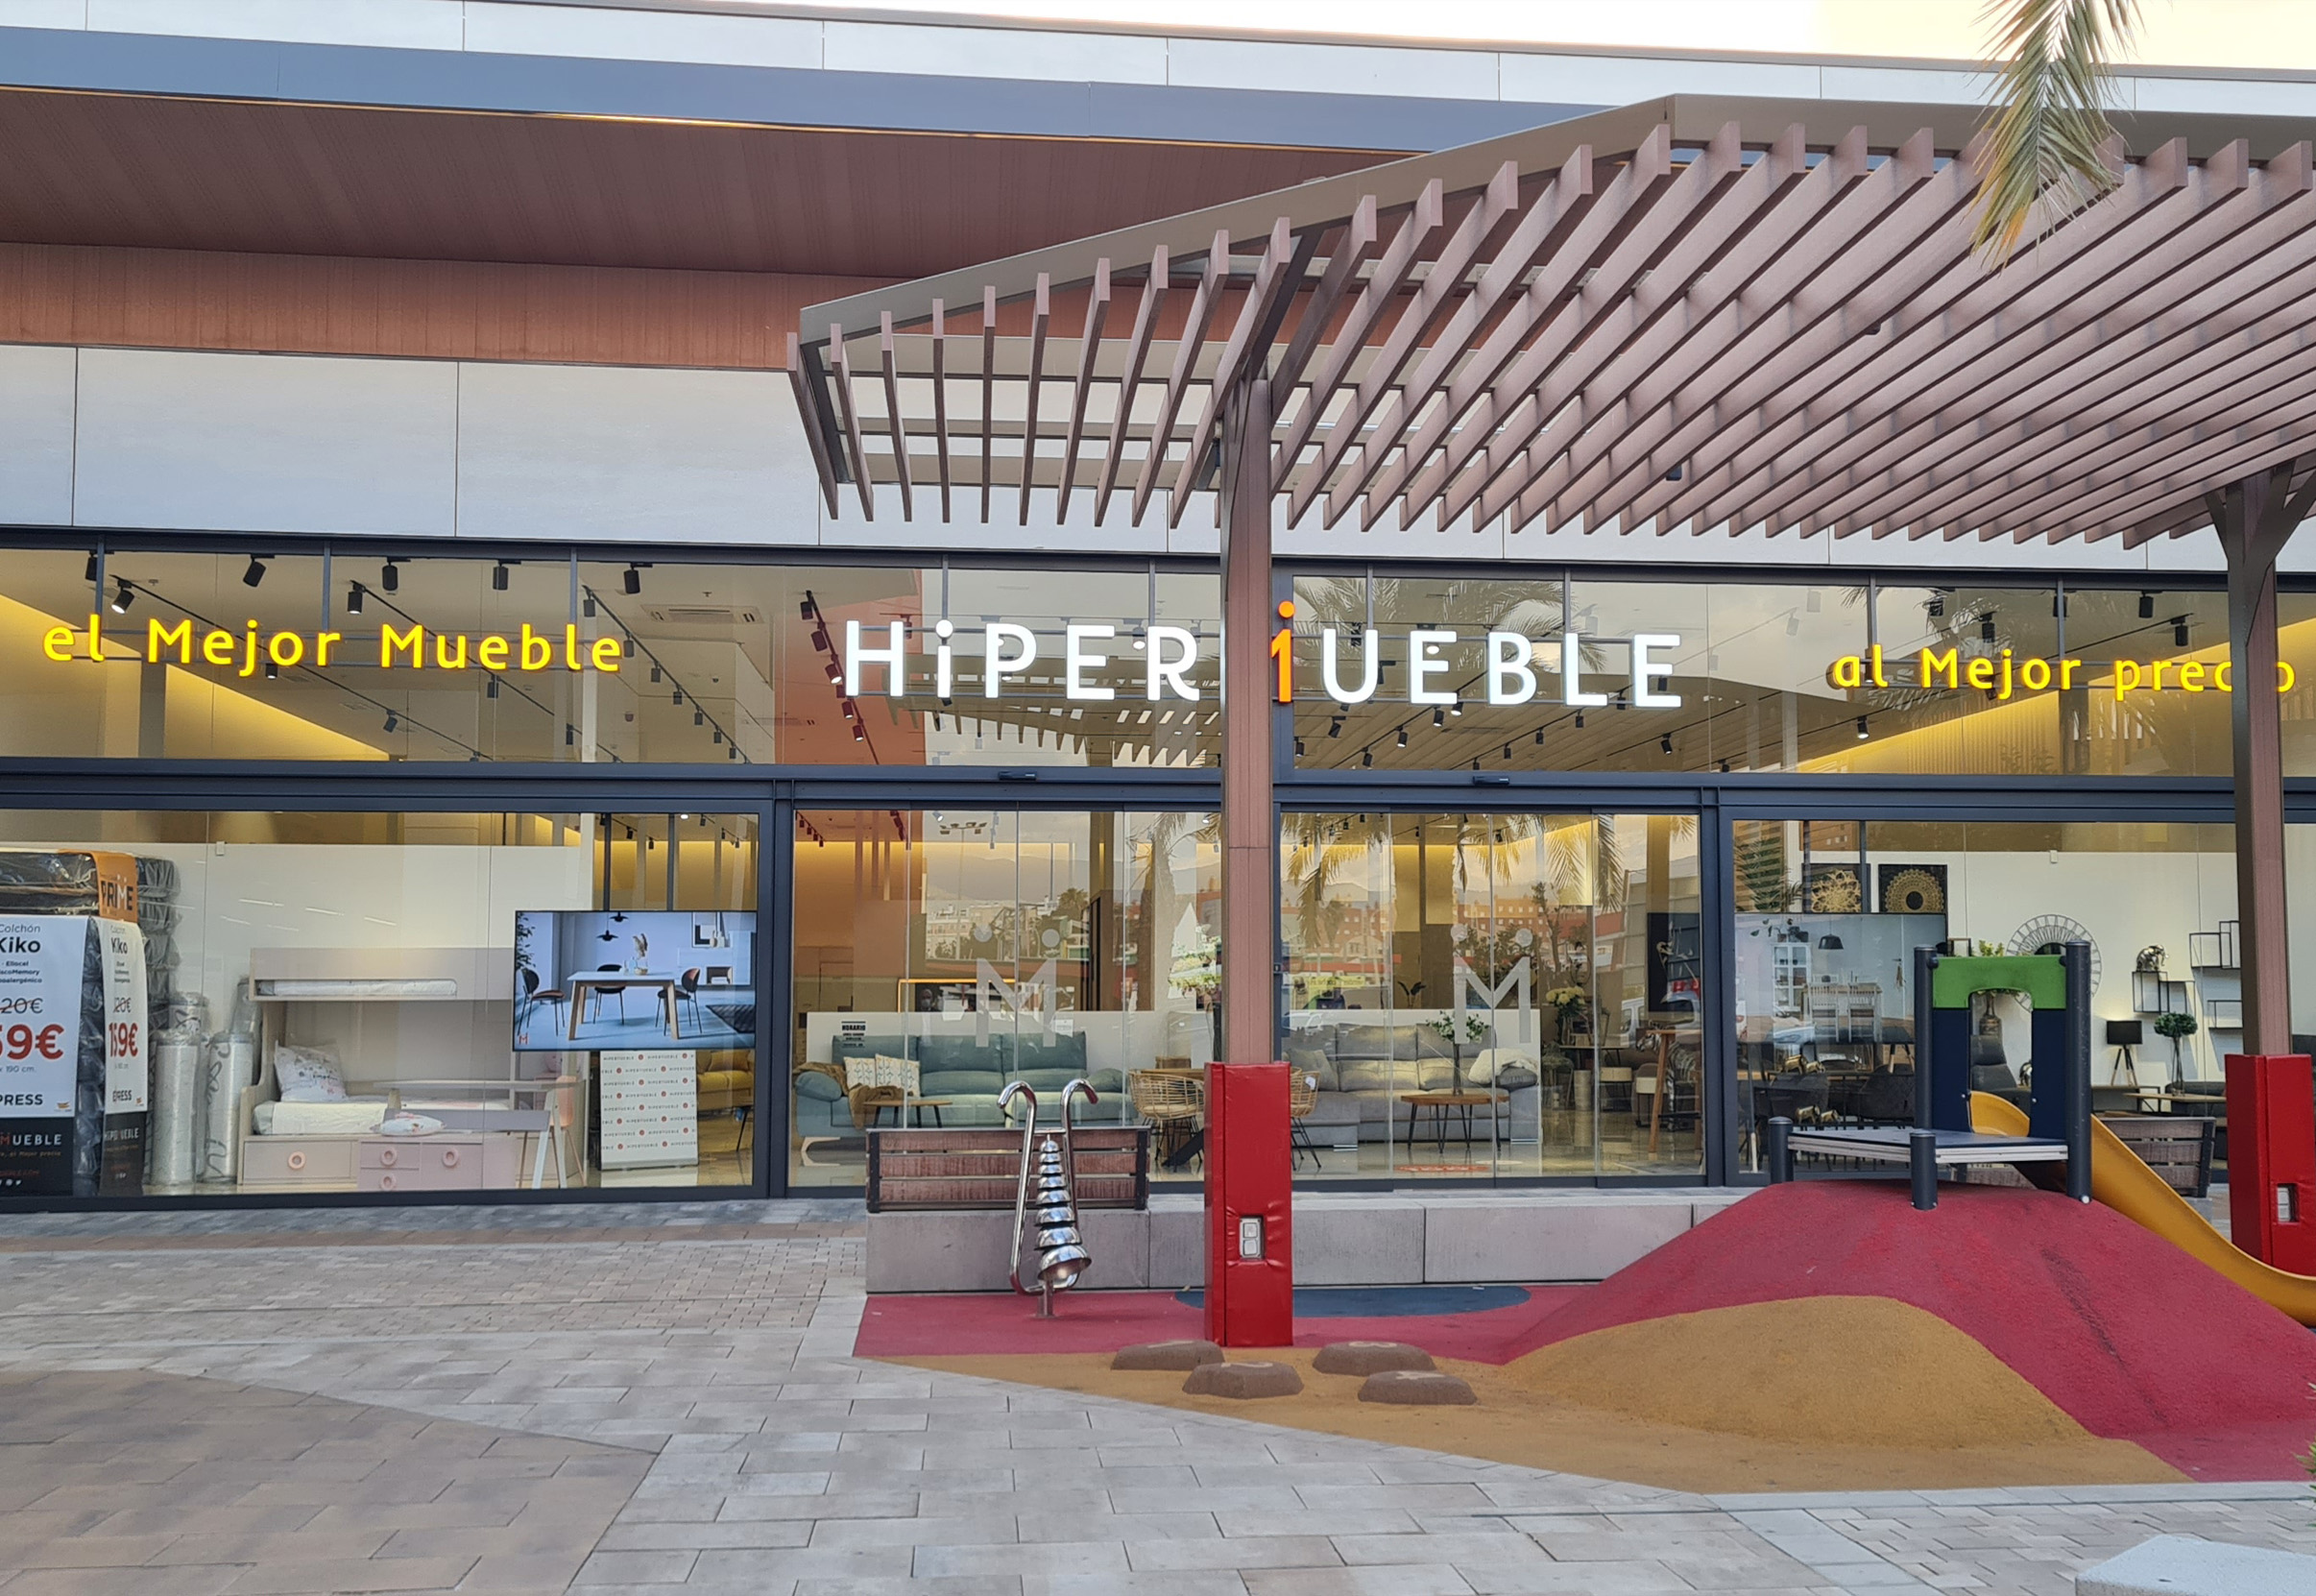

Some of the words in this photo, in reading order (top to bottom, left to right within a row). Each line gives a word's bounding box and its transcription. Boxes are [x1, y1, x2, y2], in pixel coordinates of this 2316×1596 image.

[43, 614, 104, 662] el
[148, 619, 340, 677] Mejor
[381, 623, 621, 671] Mueble
[1833, 644, 1889, 689] al
[1920, 648, 2082, 700] Mejor
[2114, 659, 2296, 702] preco
[100, 874, 134, 911] PRIME
